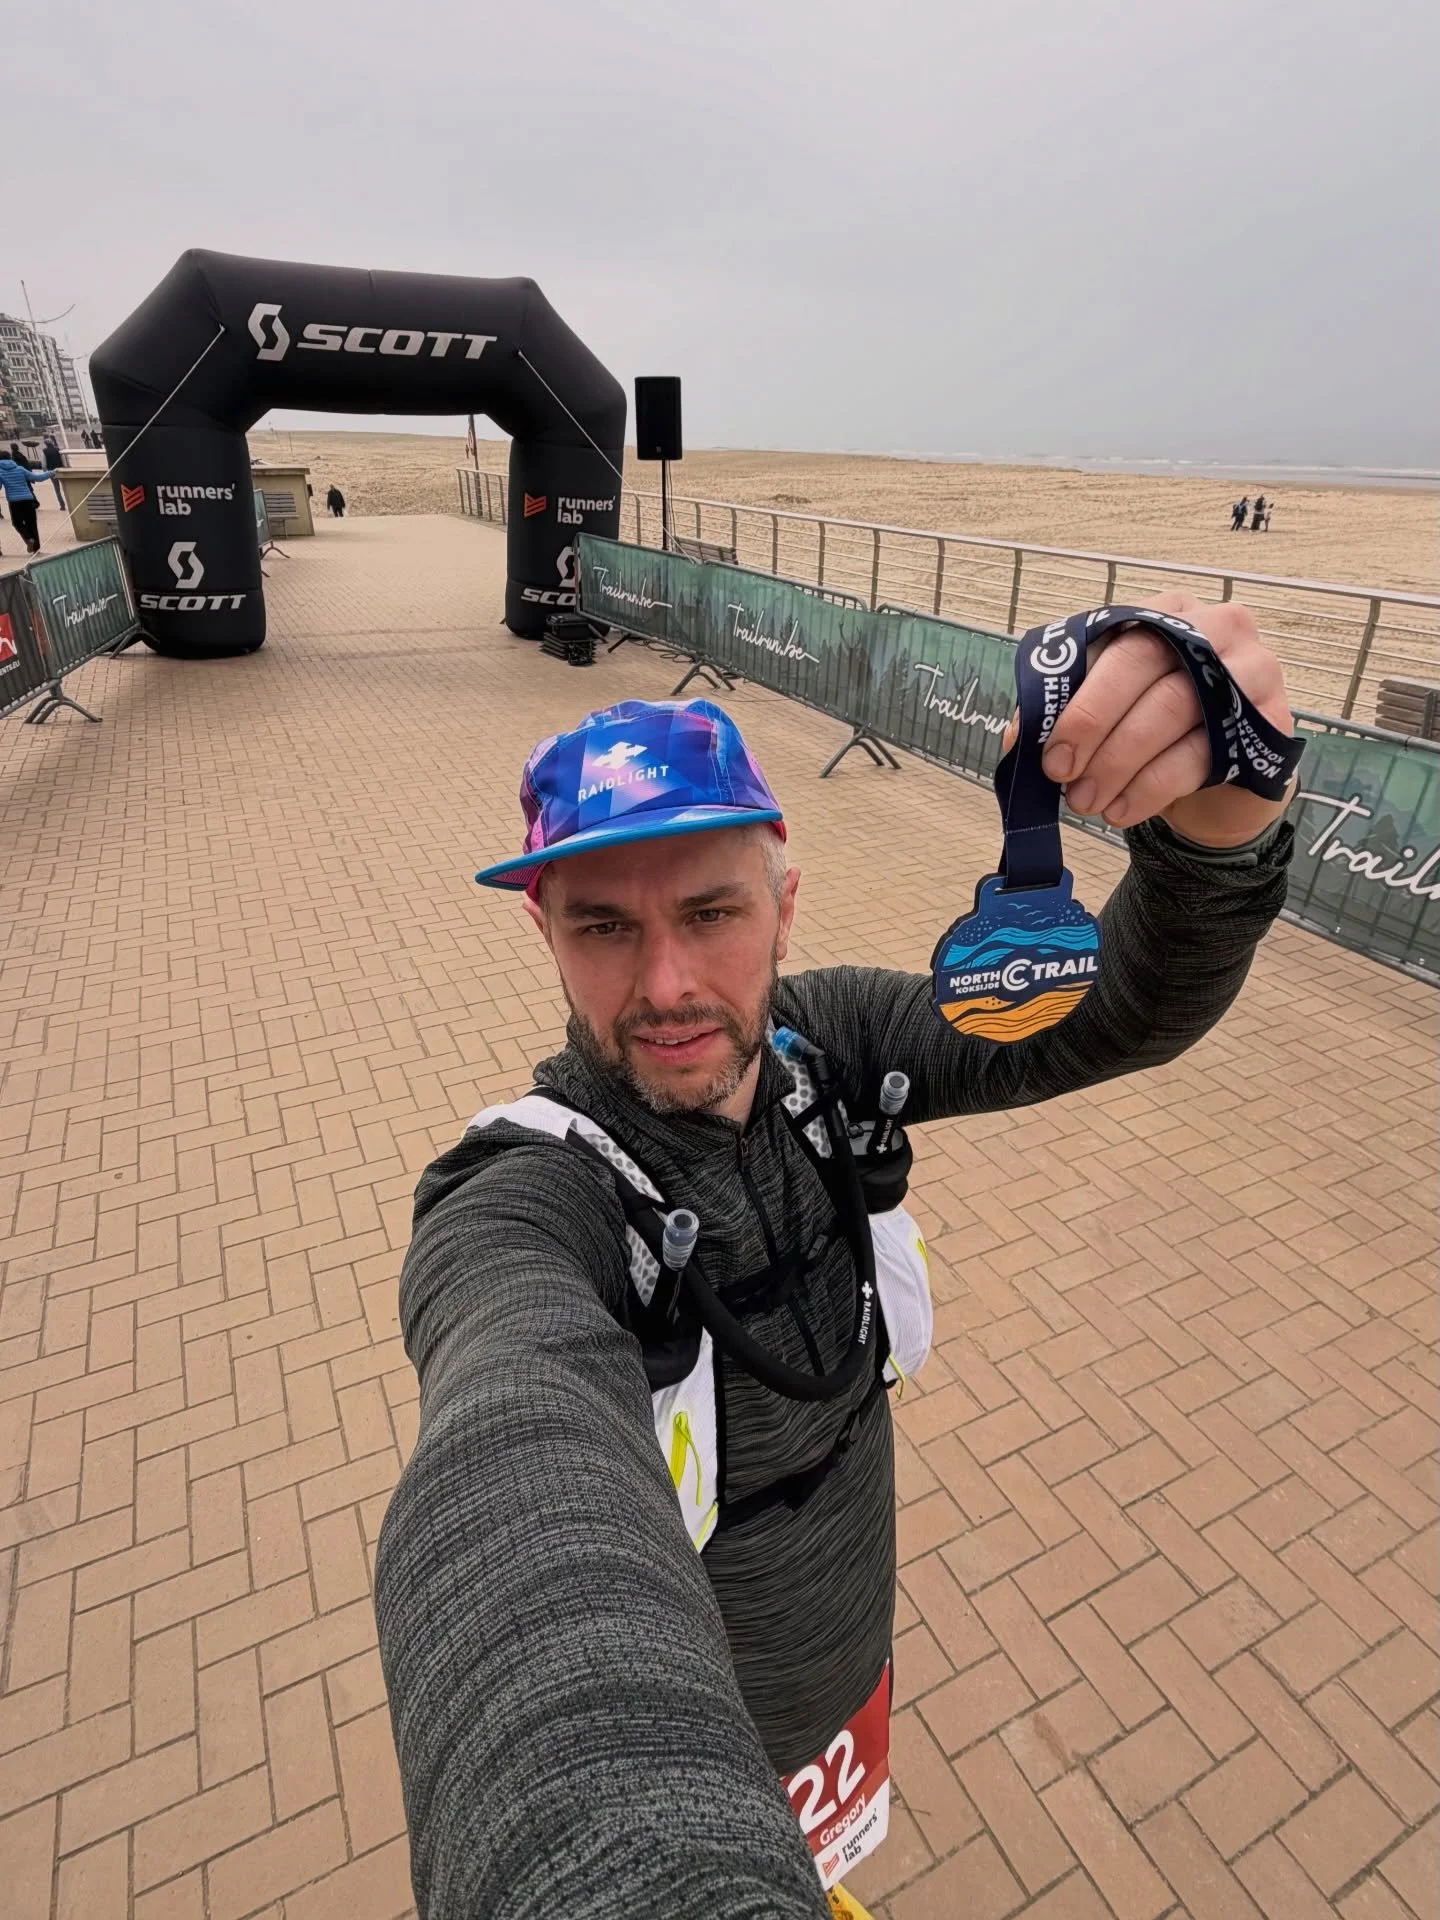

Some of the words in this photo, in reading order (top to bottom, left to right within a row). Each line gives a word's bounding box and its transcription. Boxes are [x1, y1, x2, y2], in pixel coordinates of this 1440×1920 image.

[296, 323, 498, 360] SCOTT
[156, 483, 236, 500] runners'
[158, 498, 192, 516] lab
[557, 495, 616, 511] runners'
[556, 509, 583, 525] lab
[140, 594, 247, 611] SCOTT
[520, 587, 577, 606] SCO
[727, 602, 820, 664] Trailrun.be
[914, 662, 1011, 735] Trailrun
[1038, 677, 1059, 743] NORTH
[1059, 676, 1070, 714] SIJDE
[577, 765, 669, 802] RAIDLIGHT
[1297, 793, 1440, 900] Trail
[950, 971, 1001, 988] NORTH
[1031, 955, 1099, 981] TRAIL
[955, 981, 1000, 995] KOKSIJDE
[857, 1300, 872, 1345] RAIDLIGHT
[786, 1729, 866, 1835] 22
[820, 1792, 866, 1846] Gregory
[841, 1807, 878, 1853] runners'
[844, 1844, 862, 1863] lab
